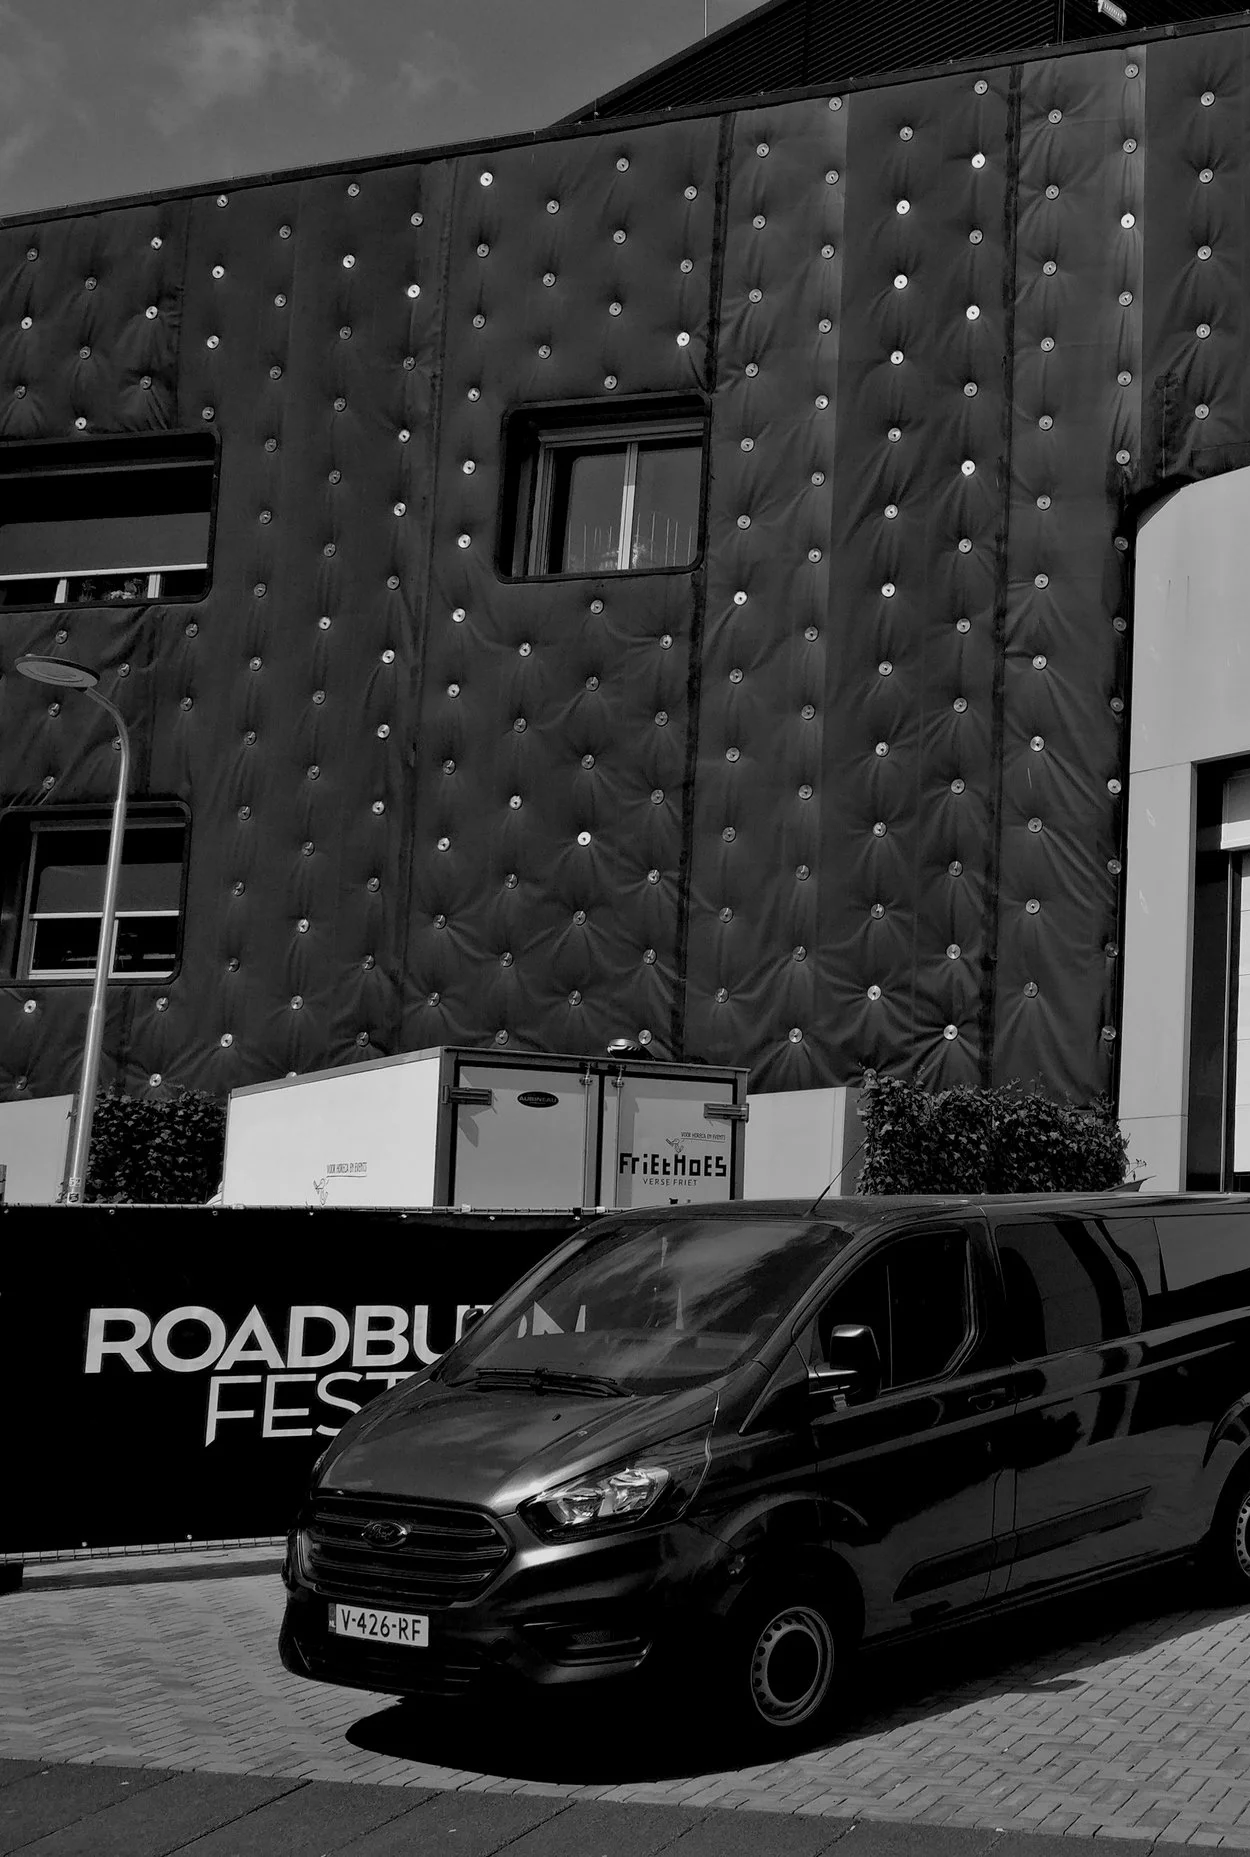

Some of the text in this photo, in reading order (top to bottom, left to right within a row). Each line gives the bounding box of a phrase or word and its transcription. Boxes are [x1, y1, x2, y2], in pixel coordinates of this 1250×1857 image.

[643, 1178, 697, 1187] VERSE FRIET
[341, 1608, 422, 1641] V-426-RF
